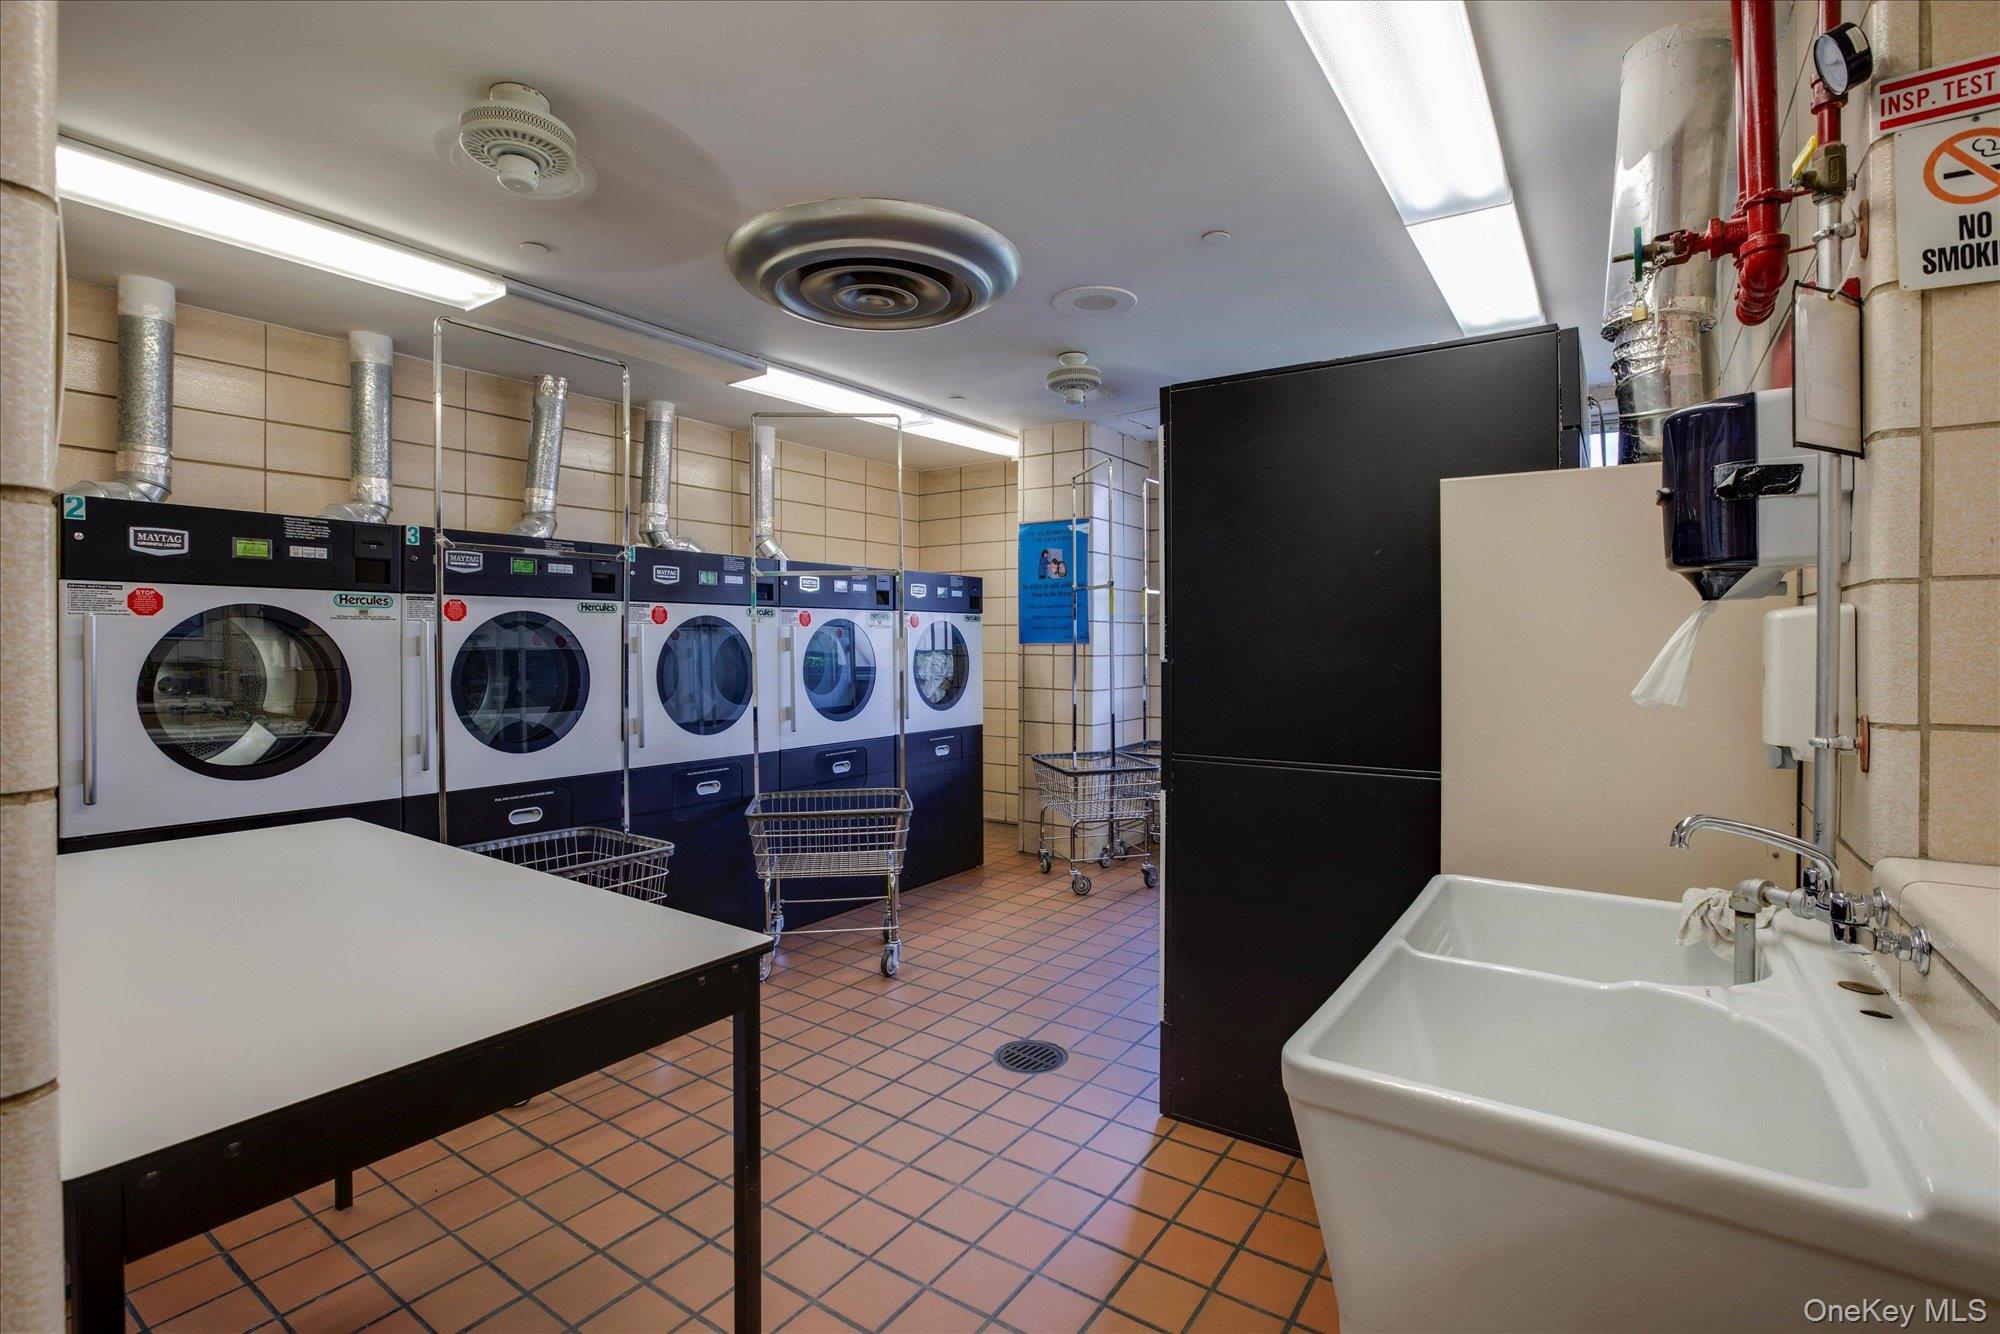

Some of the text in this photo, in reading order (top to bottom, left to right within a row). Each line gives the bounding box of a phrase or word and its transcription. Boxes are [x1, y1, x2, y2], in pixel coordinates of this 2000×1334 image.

[1881, 71, 1996, 117] INSP. TEST
[1958, 211, 1992, 241] NO
[1922, 240, 2000, 275] SMOKI
[65, 496, 84, 518] 2
[136, 532, 182, 543] MAYTAG
[407, 527, 419, 544] 3
[450, 554, 479, 563] MAYTAG
[339, 594, 389, 605] Hercules
[580, 603, 615, 612] Hercules
[748, 608, 774, 616] Hrcules
